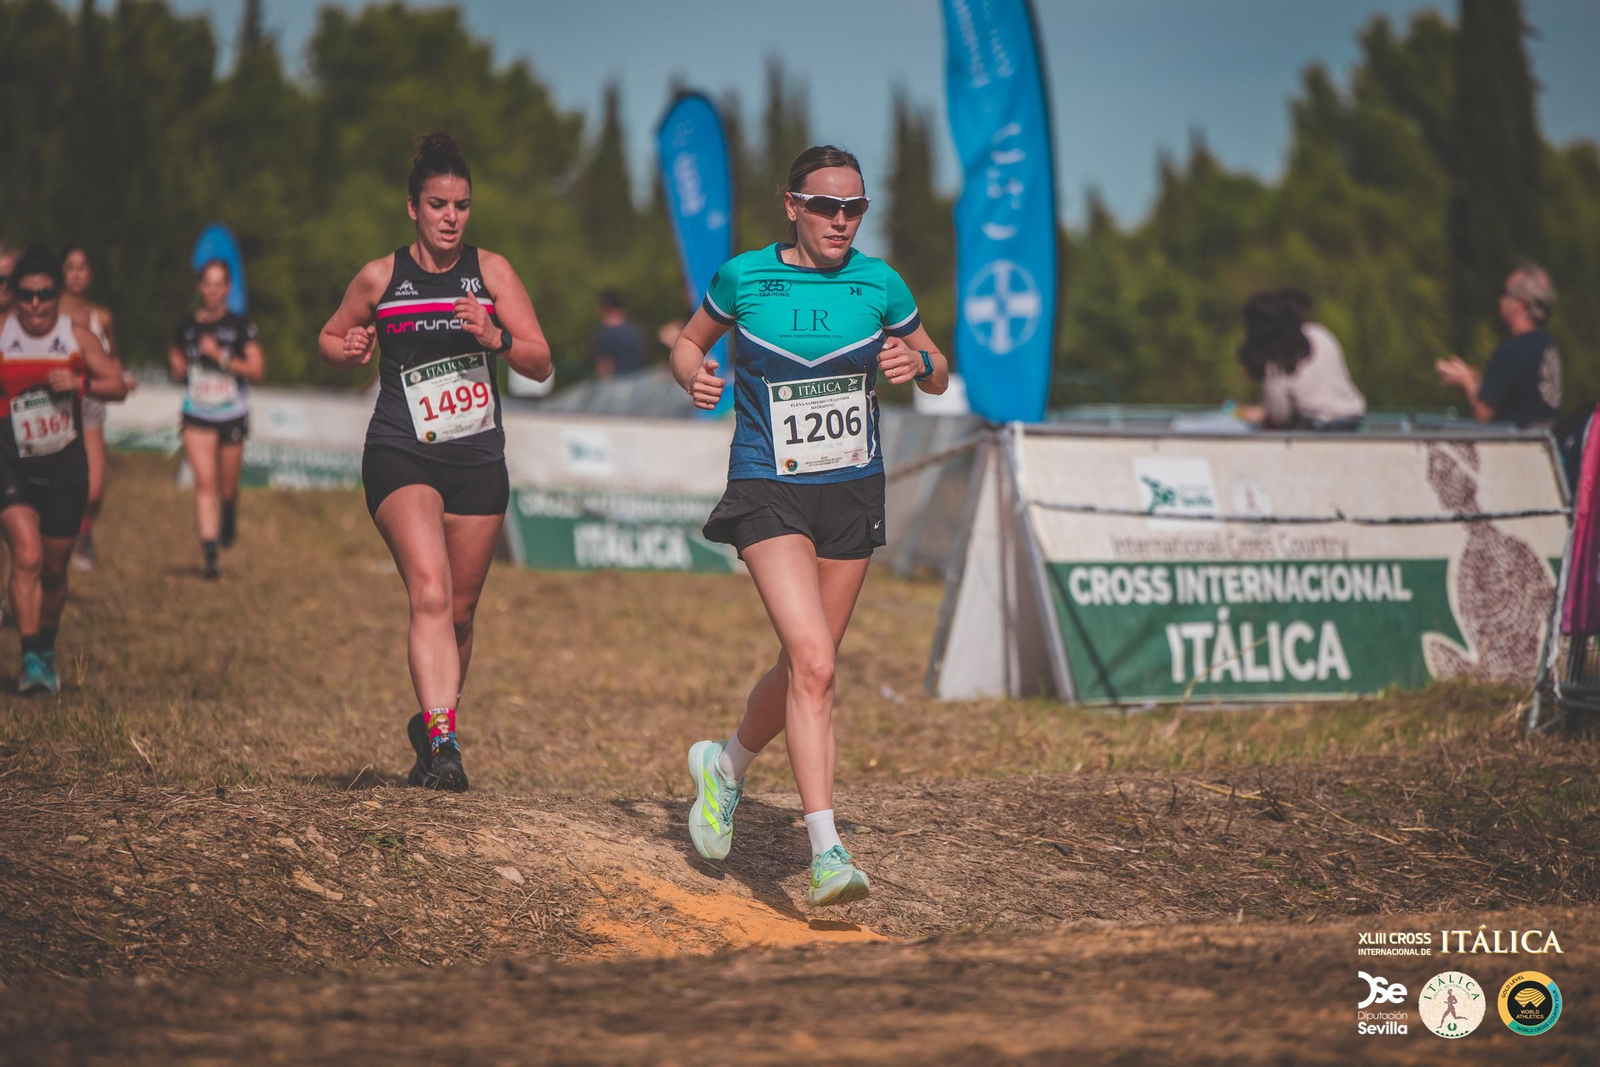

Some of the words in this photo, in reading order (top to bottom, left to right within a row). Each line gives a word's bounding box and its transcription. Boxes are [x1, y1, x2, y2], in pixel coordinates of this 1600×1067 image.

[792, 310, 831, 331] LR
[425, 360, 465, 379] ITÁLICA
[419, 382, 488, 421] 1499
[798, 381, 842, 396] ITÁLICA
[784, 406, 862, 444] 1206
[1109, 534, 1221, 558] International
[1227, 534, 1274, 558] Cross
[1277, 533, 1349, 560] Country
[1068, 566, 1173, 606] CROSS
[1175, 562, 1413, 605] INTERNACIONAL
[1165, 606, 1353, 684] ITÁLICA
